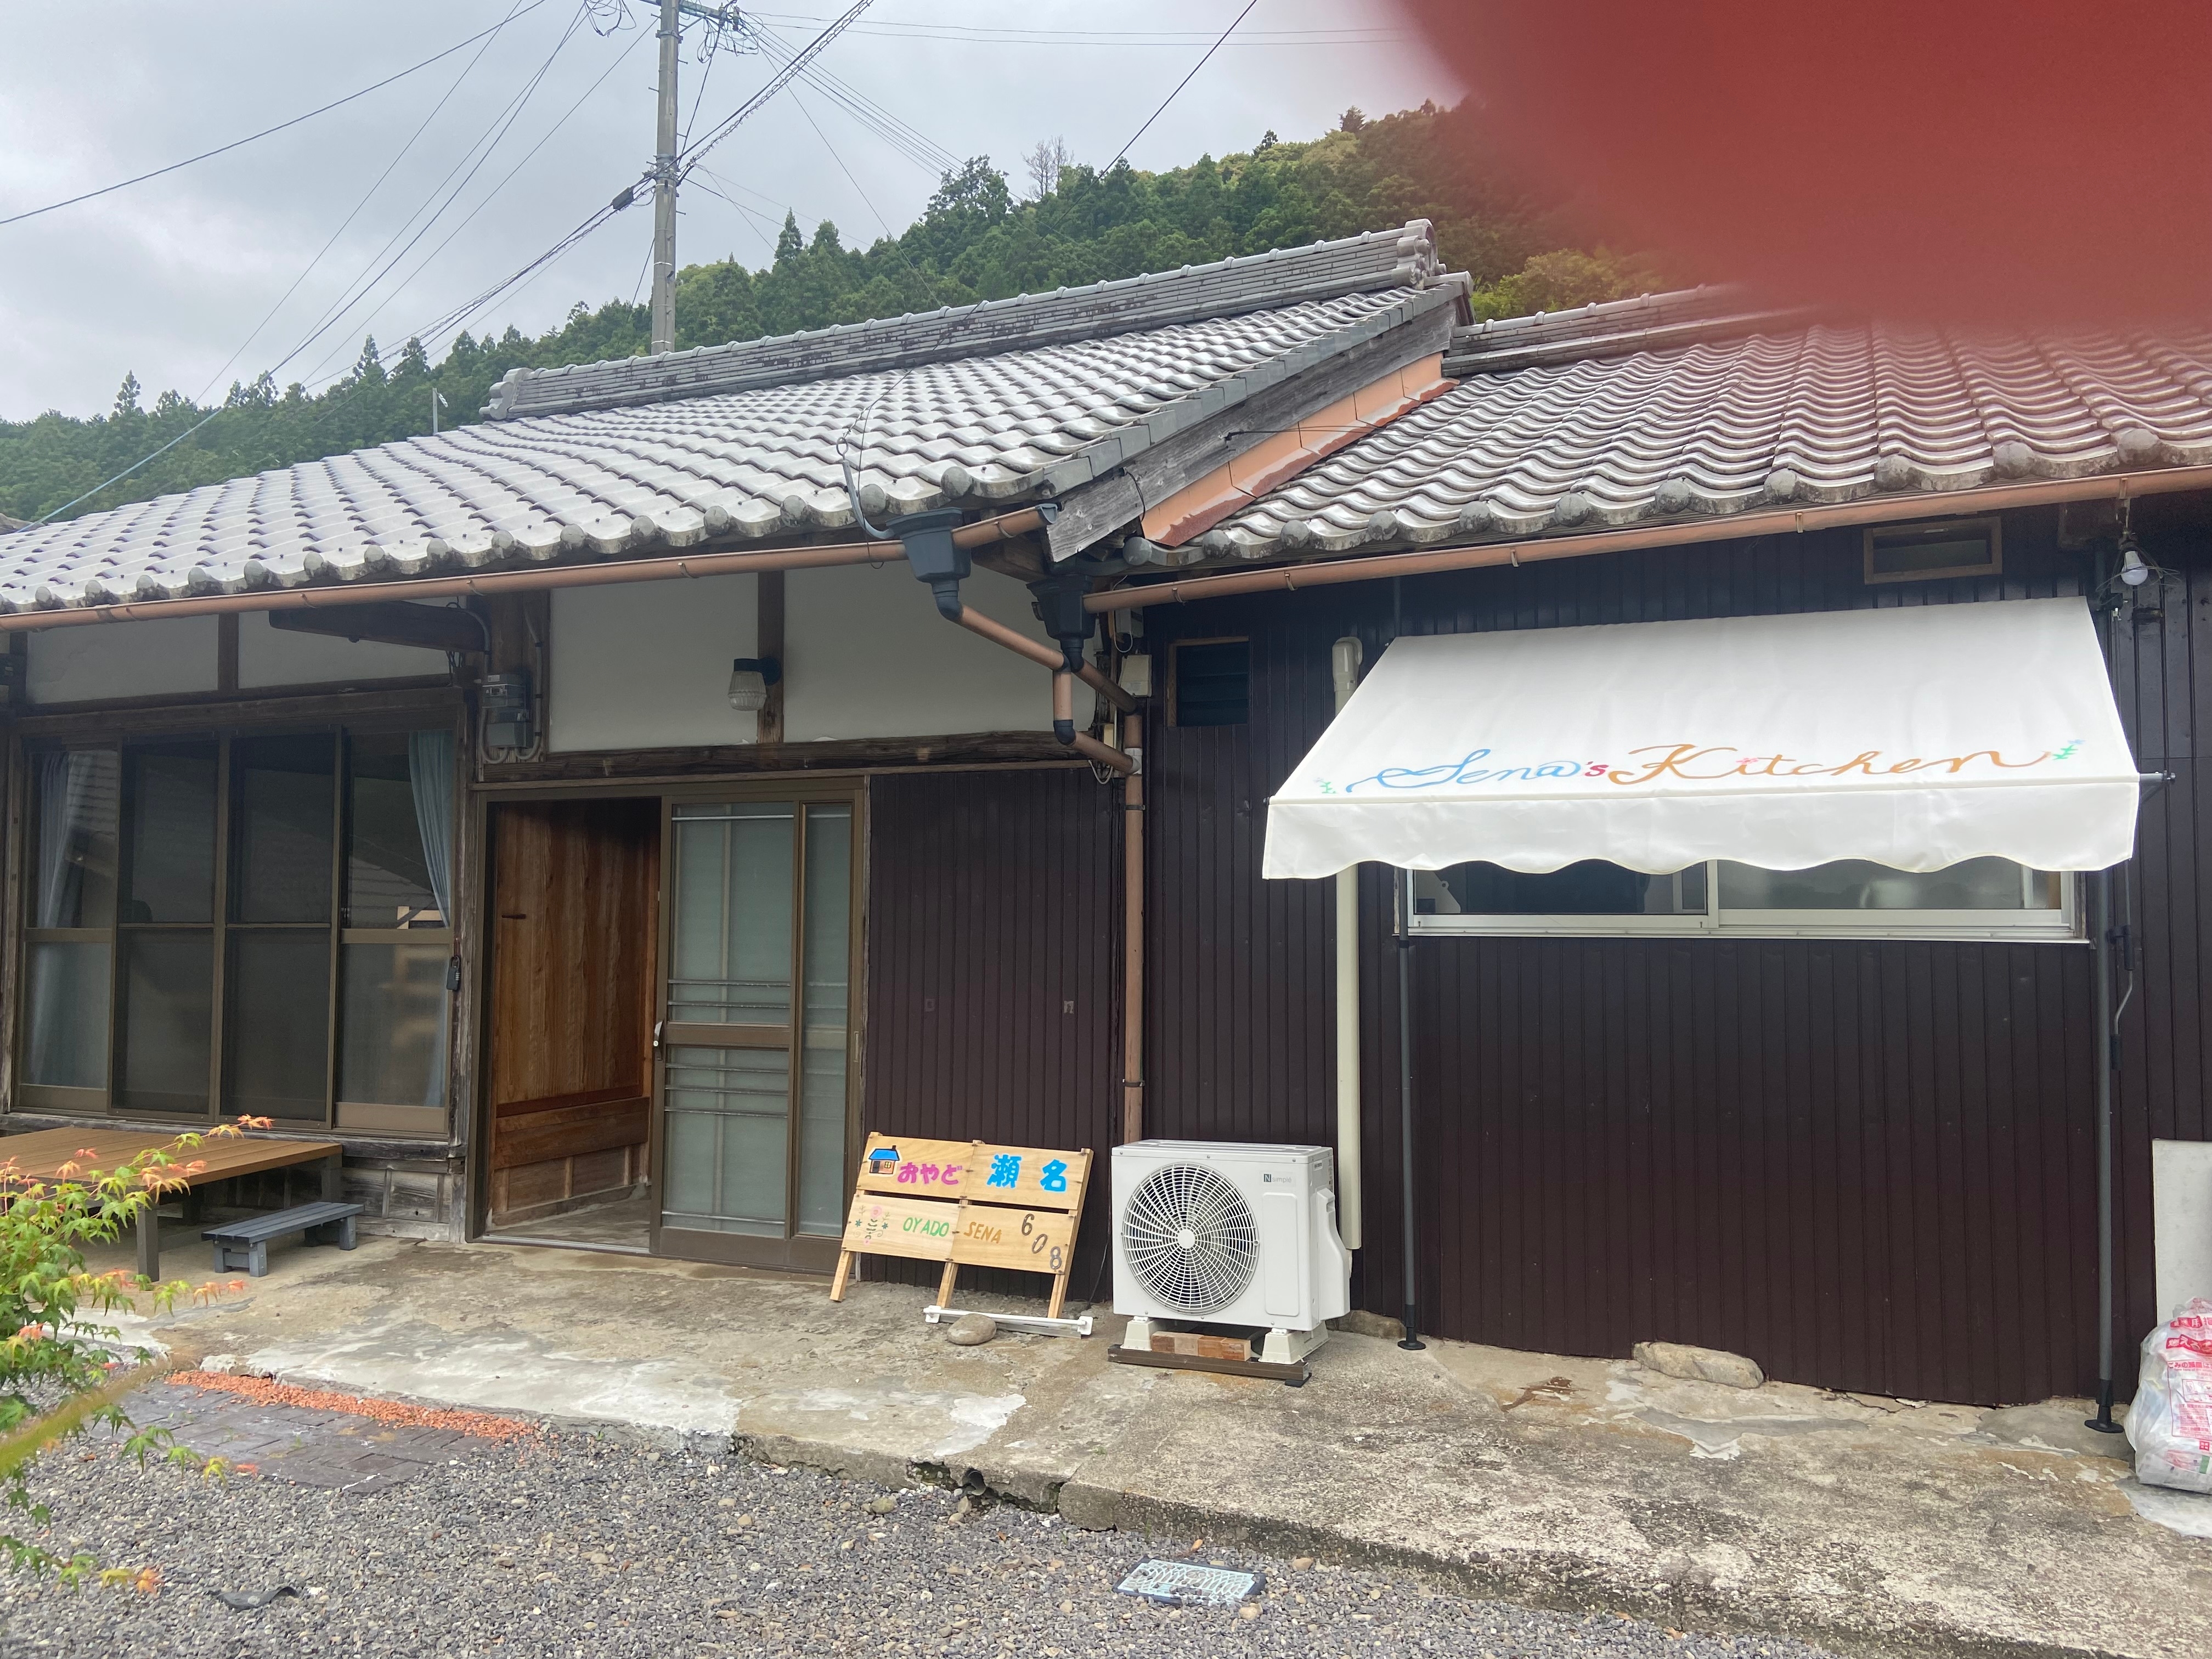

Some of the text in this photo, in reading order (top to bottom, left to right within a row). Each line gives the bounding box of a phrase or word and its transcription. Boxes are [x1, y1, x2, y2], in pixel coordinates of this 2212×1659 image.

[1608, 744, 2052, 785] Kitchen
[898, 1154, 1067, 1192] おやど 瀬名
[902, 1216, 1002, 1244] OYADO SENA
[1022, 1214, 1062, 1270] 608
